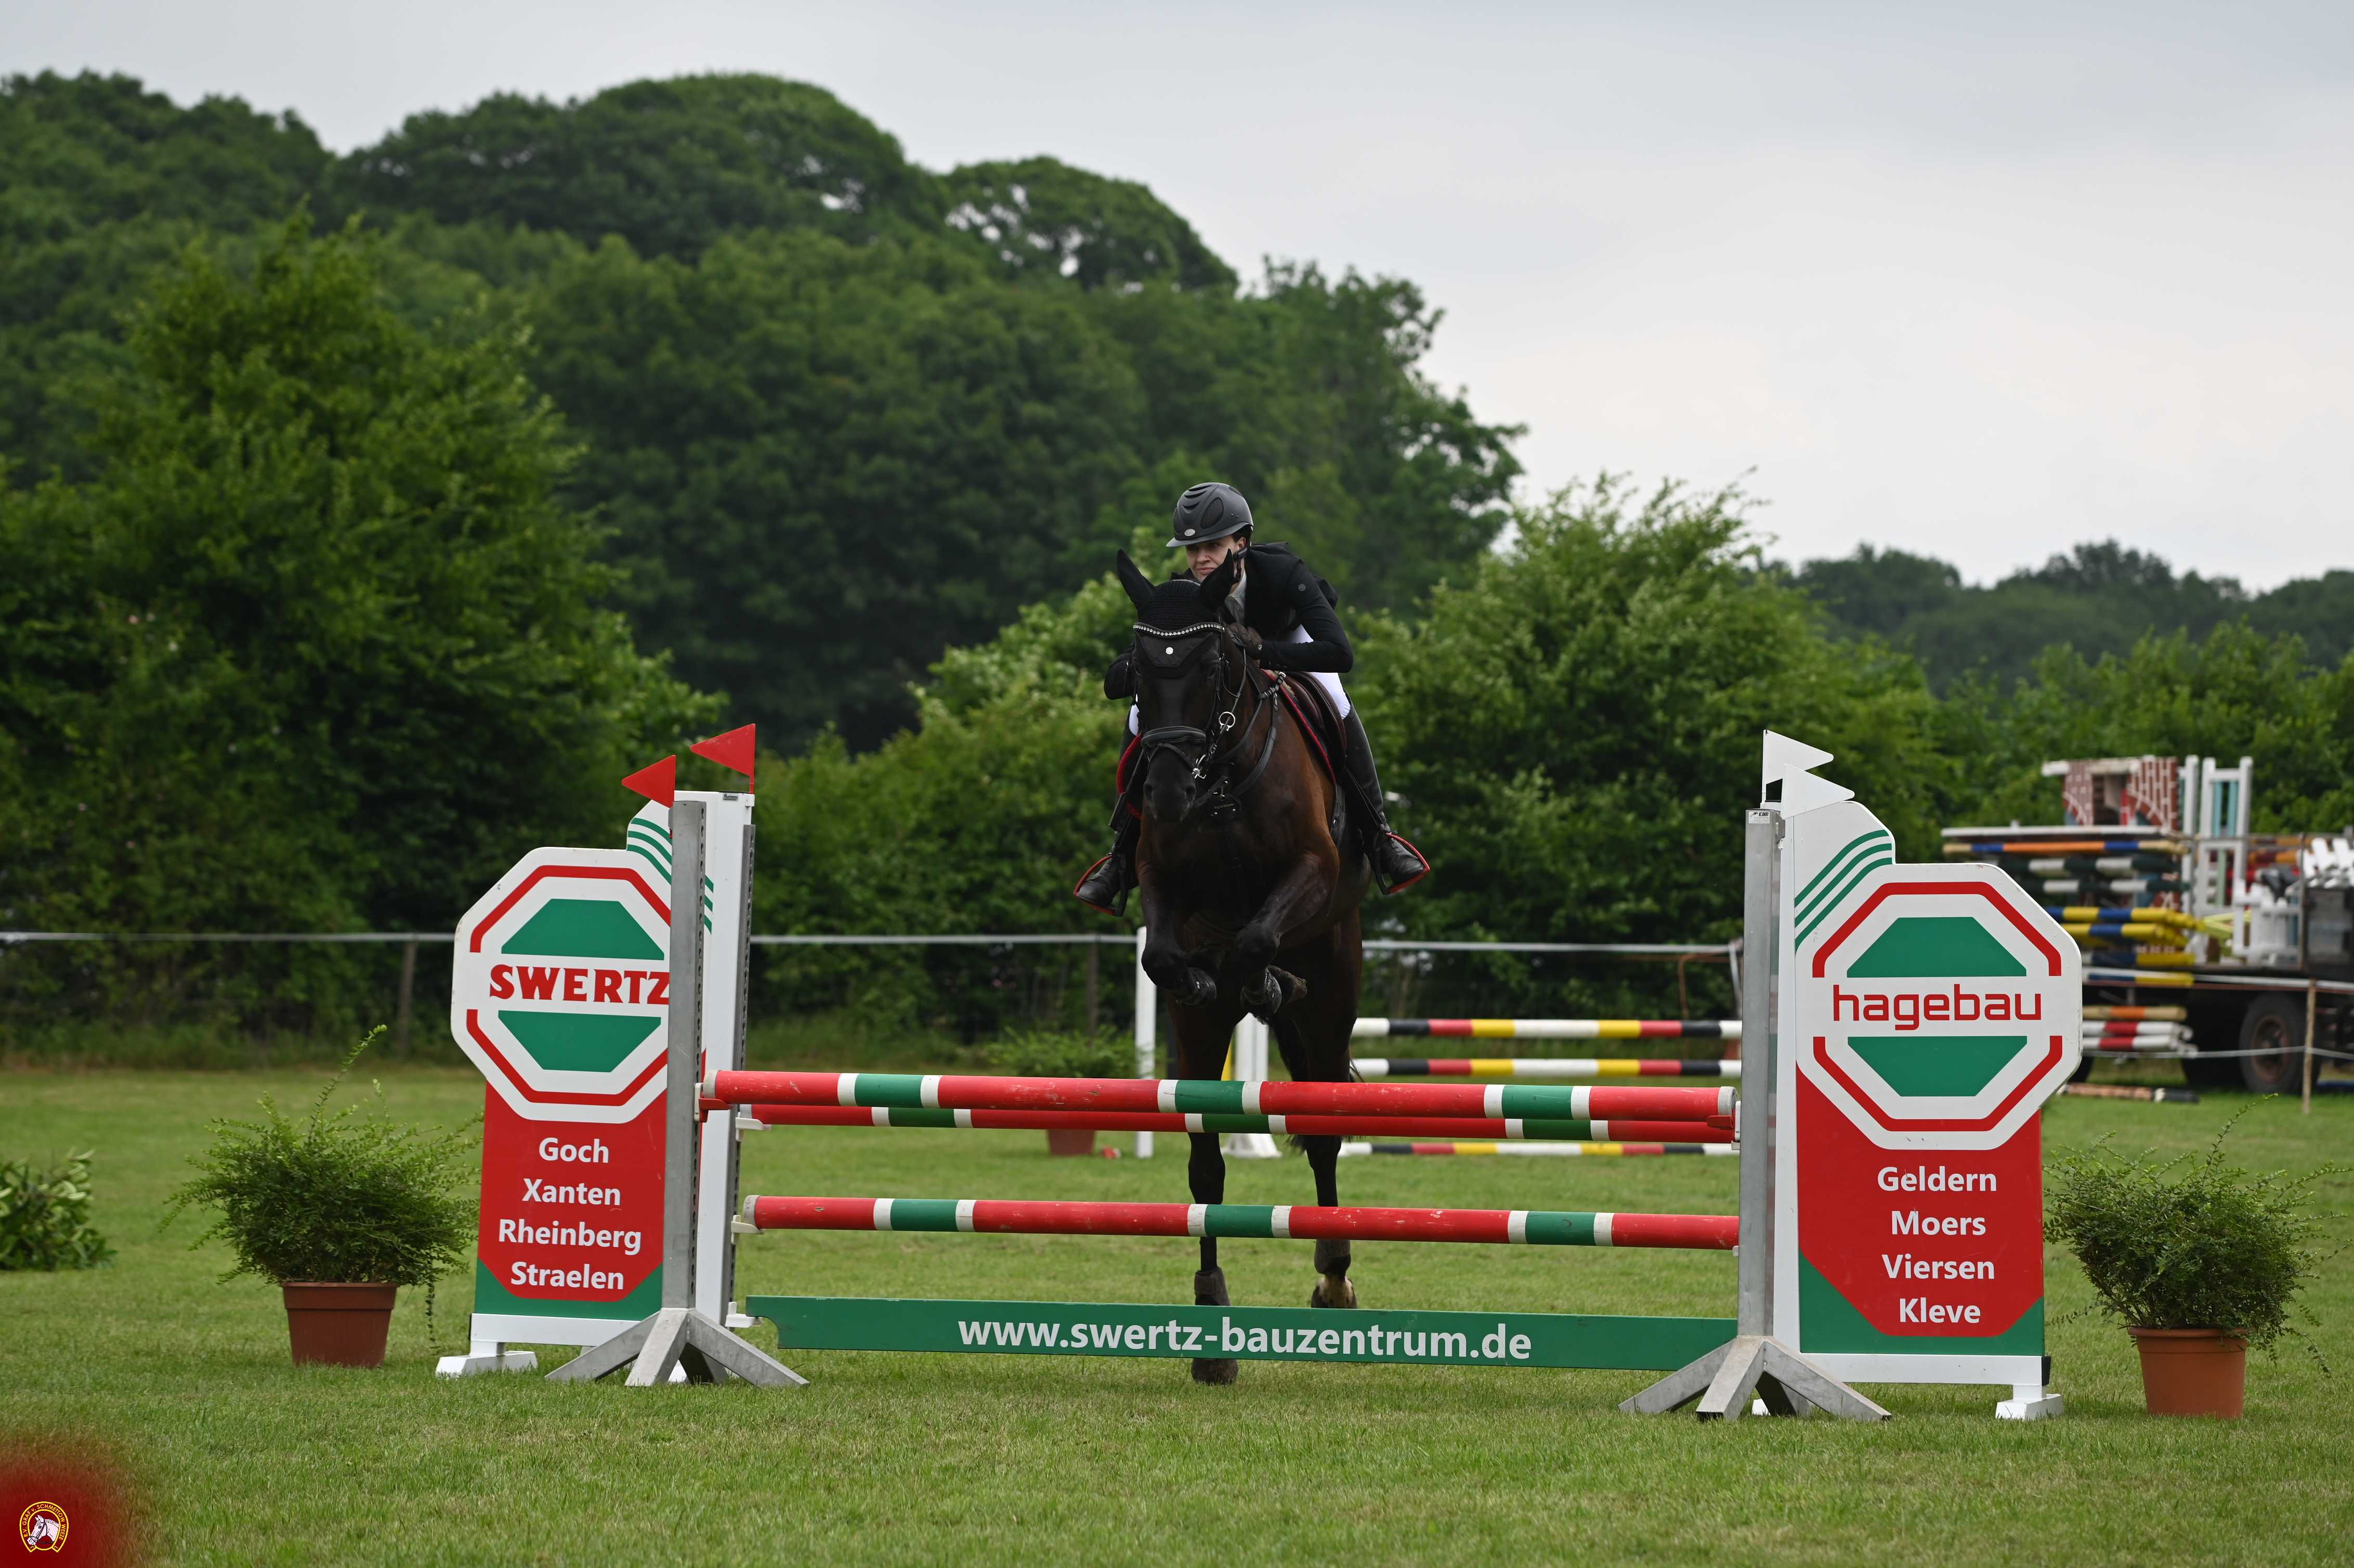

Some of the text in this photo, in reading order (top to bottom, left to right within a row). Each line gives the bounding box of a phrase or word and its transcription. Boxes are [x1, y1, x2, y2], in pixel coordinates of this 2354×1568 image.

[490, 964, 669, 1004] SWERTZ
[1833, 984, 2042, 1030] hagebau
[539, 1137, 609, 1163] Goch
[522, 1178, 620, 1206] Xanten
[1877, 1166, 1997, 1192] Geldern
[1891, 1210, 1986, 1235] Moers
[499, 1219, 641, 1255] Rheinberg
[511, 1261, 624, 1290] Straelen
[1882, 1254, 1995, 1279] Viersen
[1900, 1298, 1981, 1323] Kleve
[958, 1317, 1531, 1359] www.swertz-bauzentrum.de
